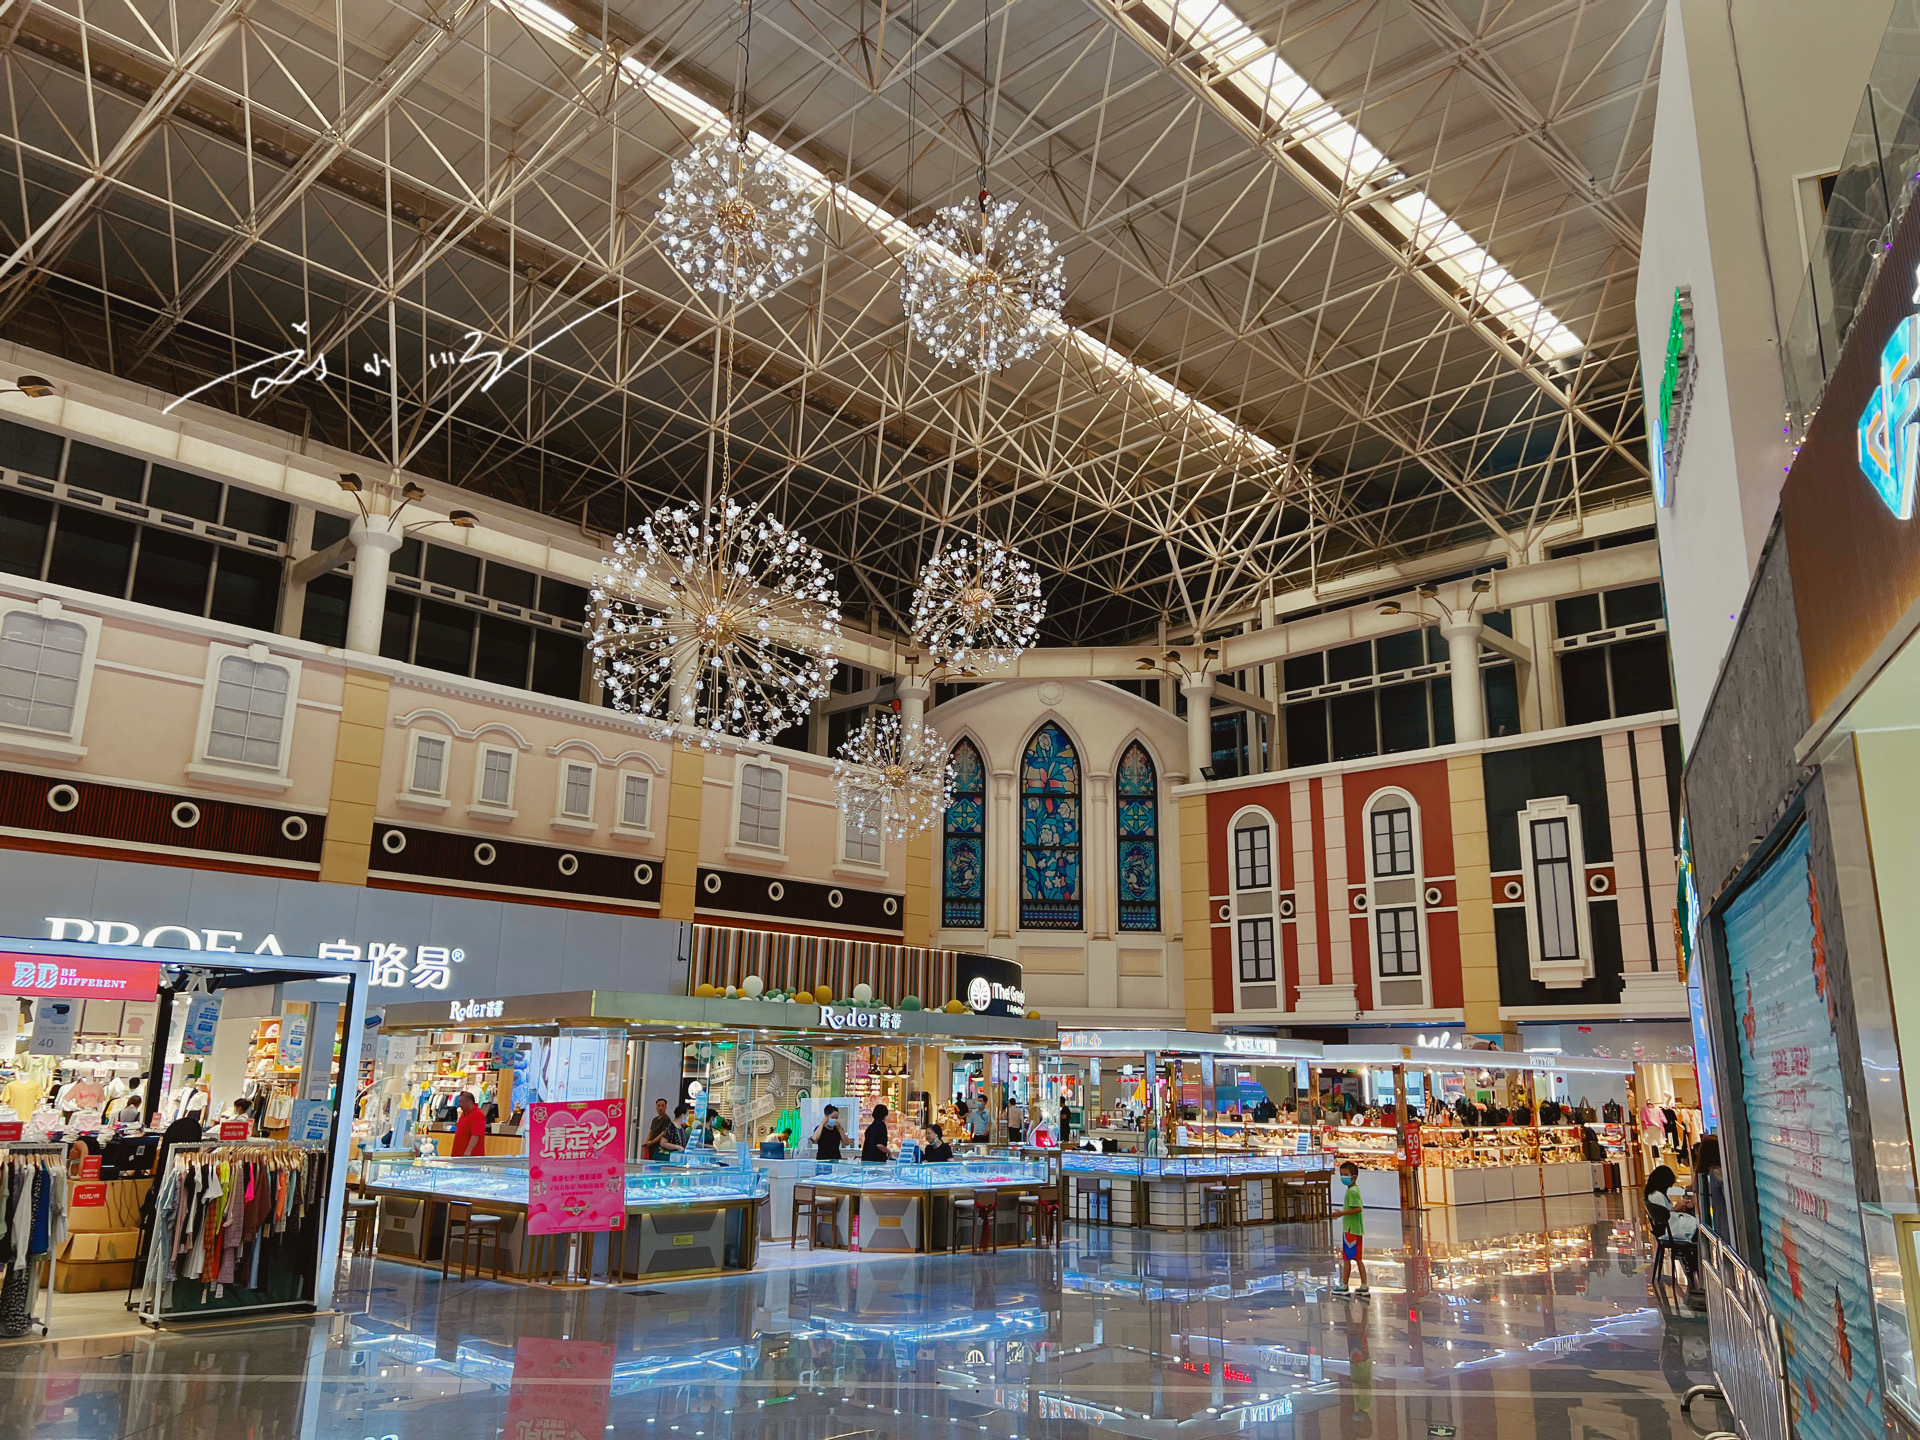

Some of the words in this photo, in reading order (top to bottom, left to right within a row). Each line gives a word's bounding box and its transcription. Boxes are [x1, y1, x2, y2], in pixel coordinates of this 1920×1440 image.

[61, 968, 77, 977] BE
[59, 977, 127, 989] DIFFERENT
[449, 998, 486, 1022] Roder
[819, 1005, 877, 1030] Roder
[878, 1012, 902, 1029] 诺蒂
[38, 1038, 54, 1048] 40
[394, 1051, 405, 1060] 20
[539, 1121, 618, 1160] 情定七夕
[1407, 1134, 1420, 1150] 59
